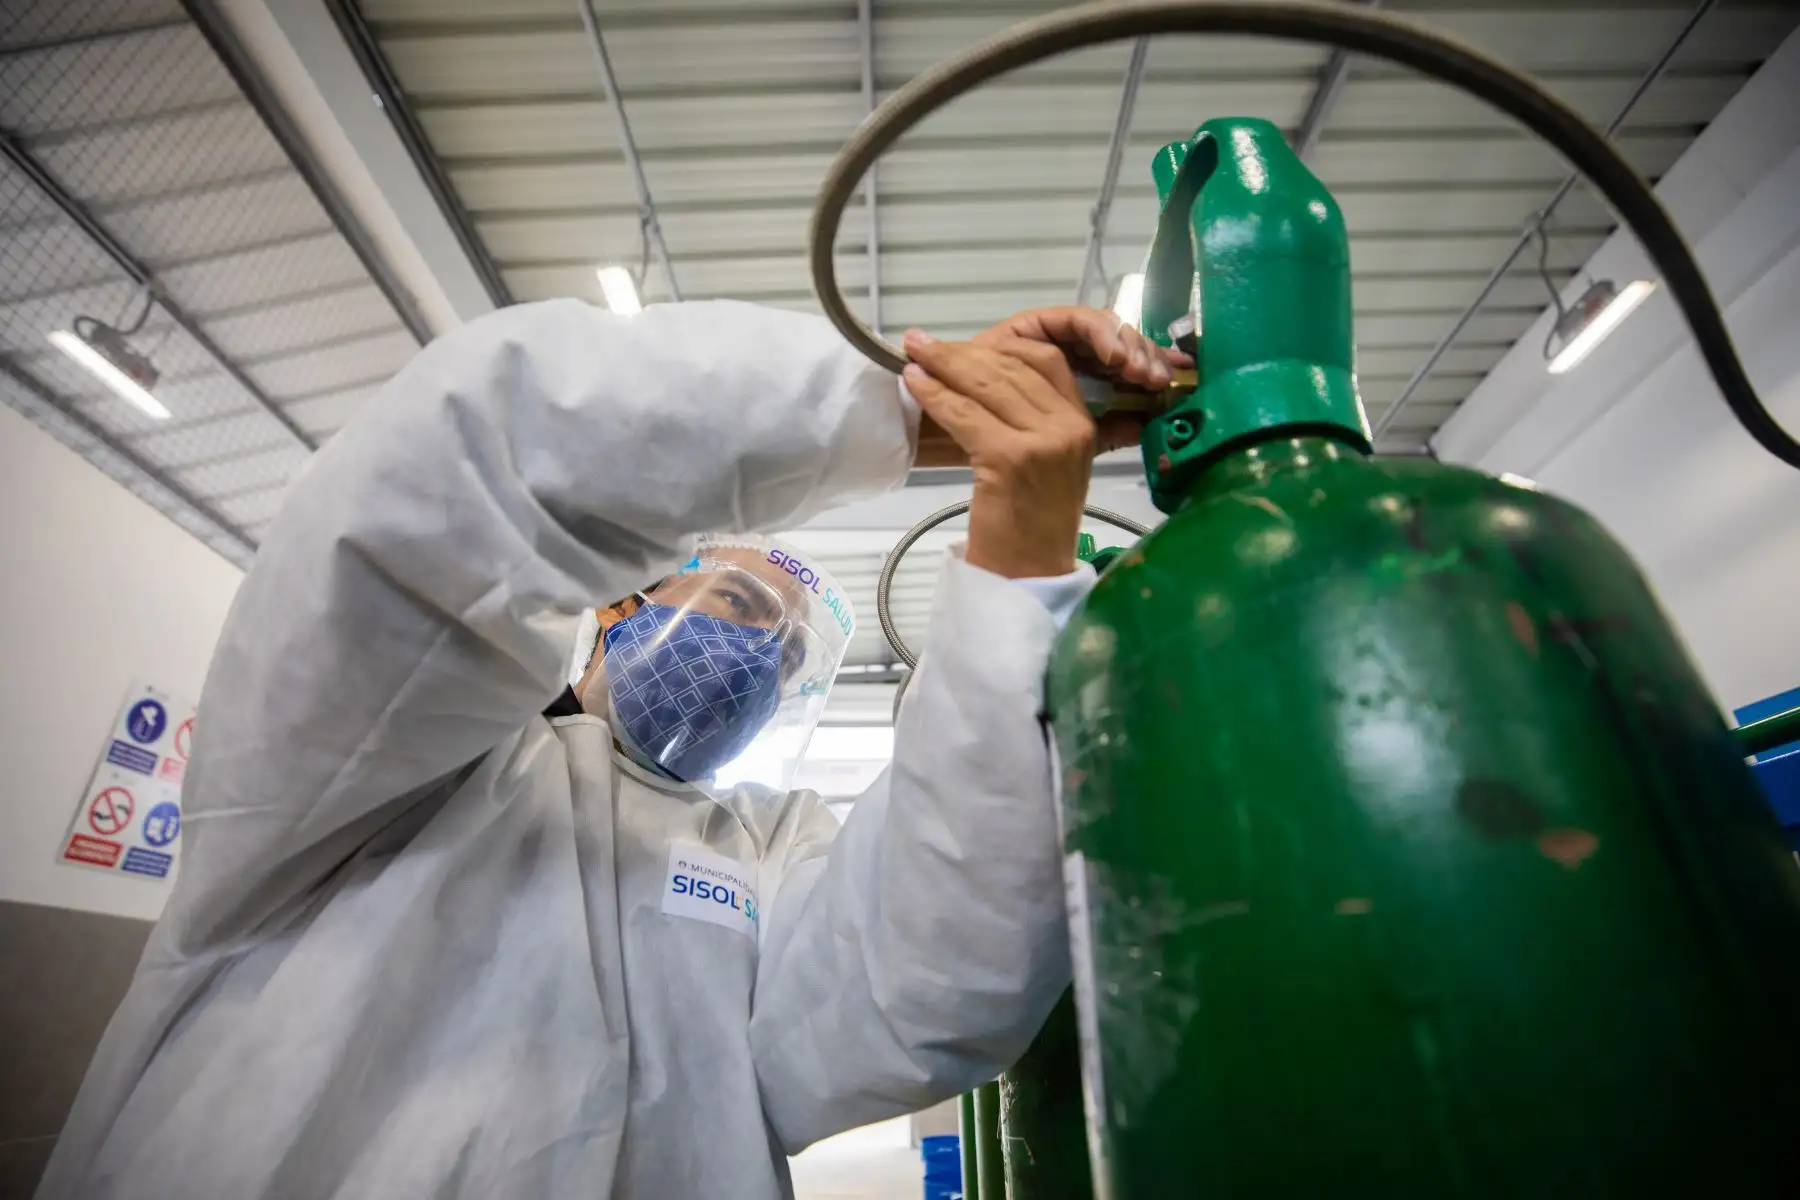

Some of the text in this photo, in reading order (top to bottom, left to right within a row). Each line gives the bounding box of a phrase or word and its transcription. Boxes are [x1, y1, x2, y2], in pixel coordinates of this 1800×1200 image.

[766, 549, 853, 636] SISOL SALUD
[672, 874, 740, 910] SISOL
